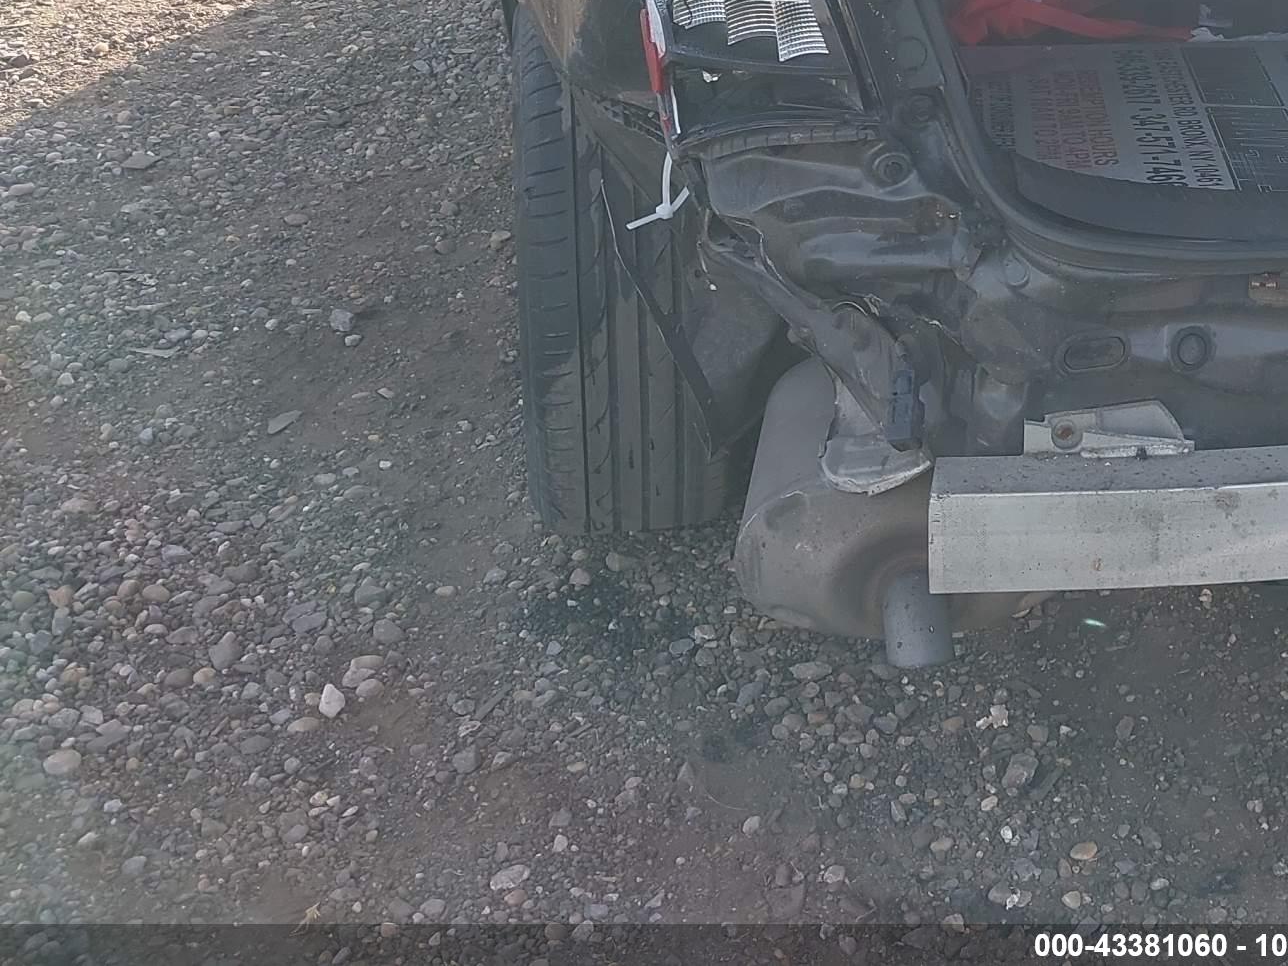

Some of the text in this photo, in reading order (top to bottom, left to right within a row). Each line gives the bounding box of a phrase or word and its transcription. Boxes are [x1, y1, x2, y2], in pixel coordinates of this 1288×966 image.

[1061, 130, 1089, 144] TO
[1088, 129, 1120, 166] HOURS
[1063, 146, 1092, 168] 4PM
[1189, 151, 1217, 162] NY
[1192, 163, 1224, 187] 10461
